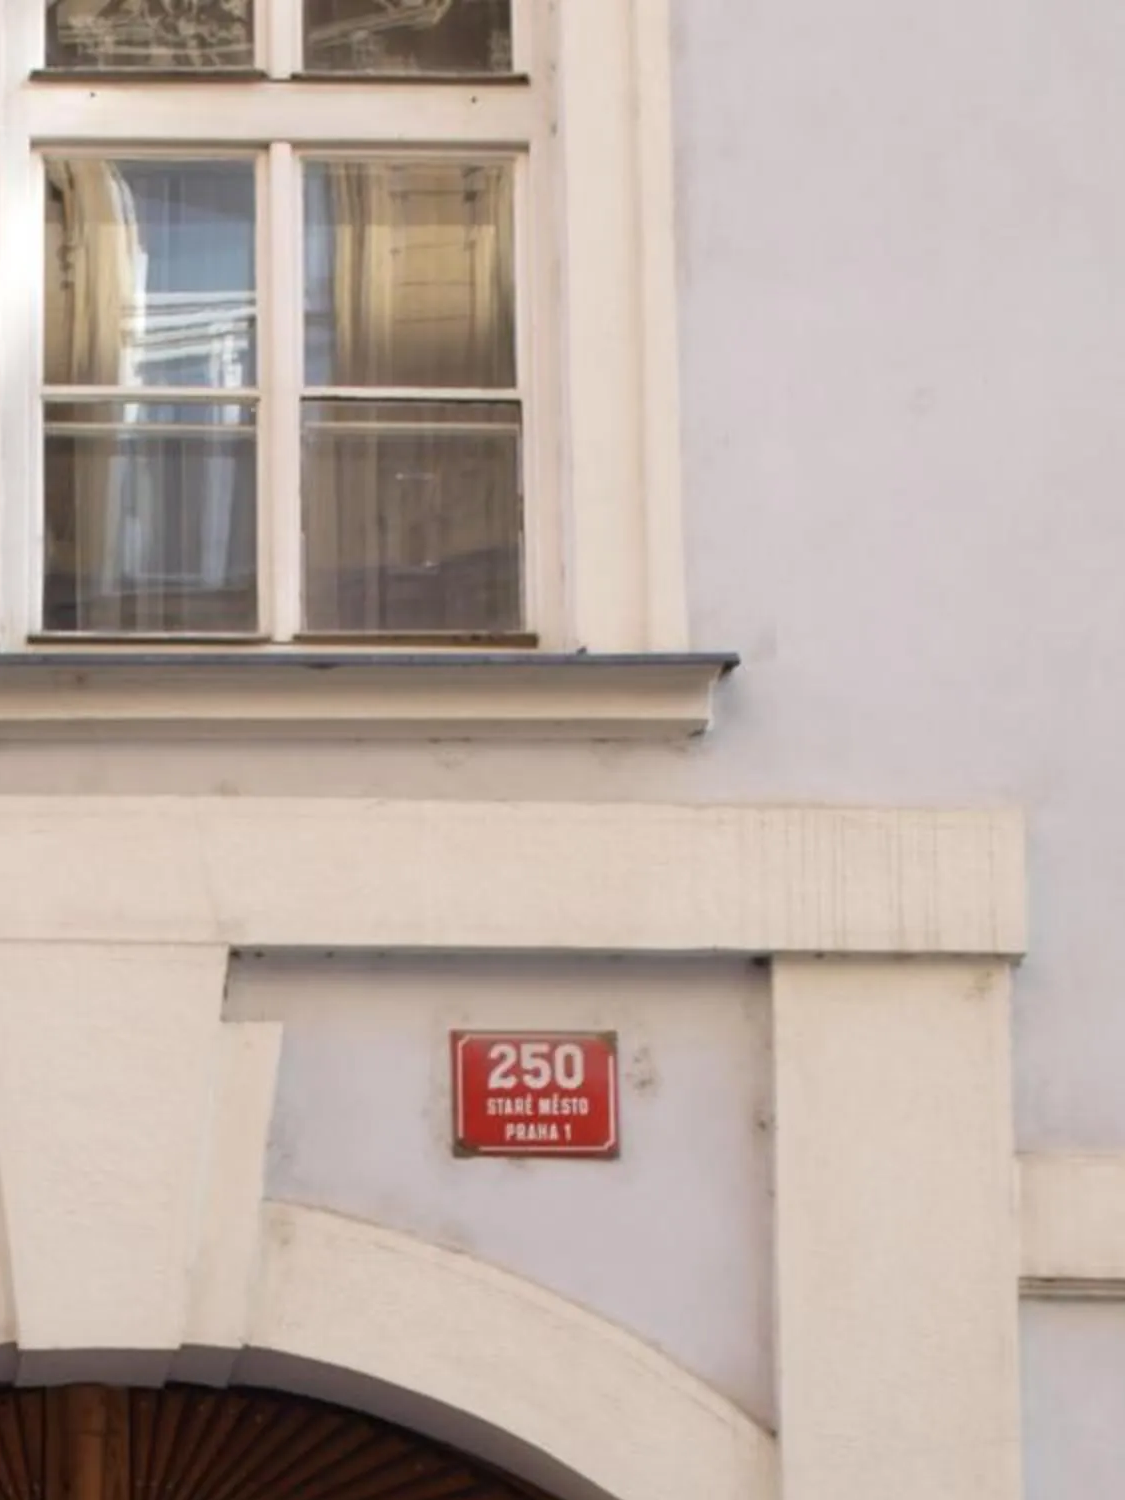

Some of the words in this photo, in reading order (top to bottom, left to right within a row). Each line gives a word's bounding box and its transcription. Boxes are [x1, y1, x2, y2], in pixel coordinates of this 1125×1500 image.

[487, 1043, 584, 1089] 250
[486, 1093, 534, 1115] STARÉ
[505, 1122, 559, 1141] PRAHA
[564, 1122, 572, 1141] 1
